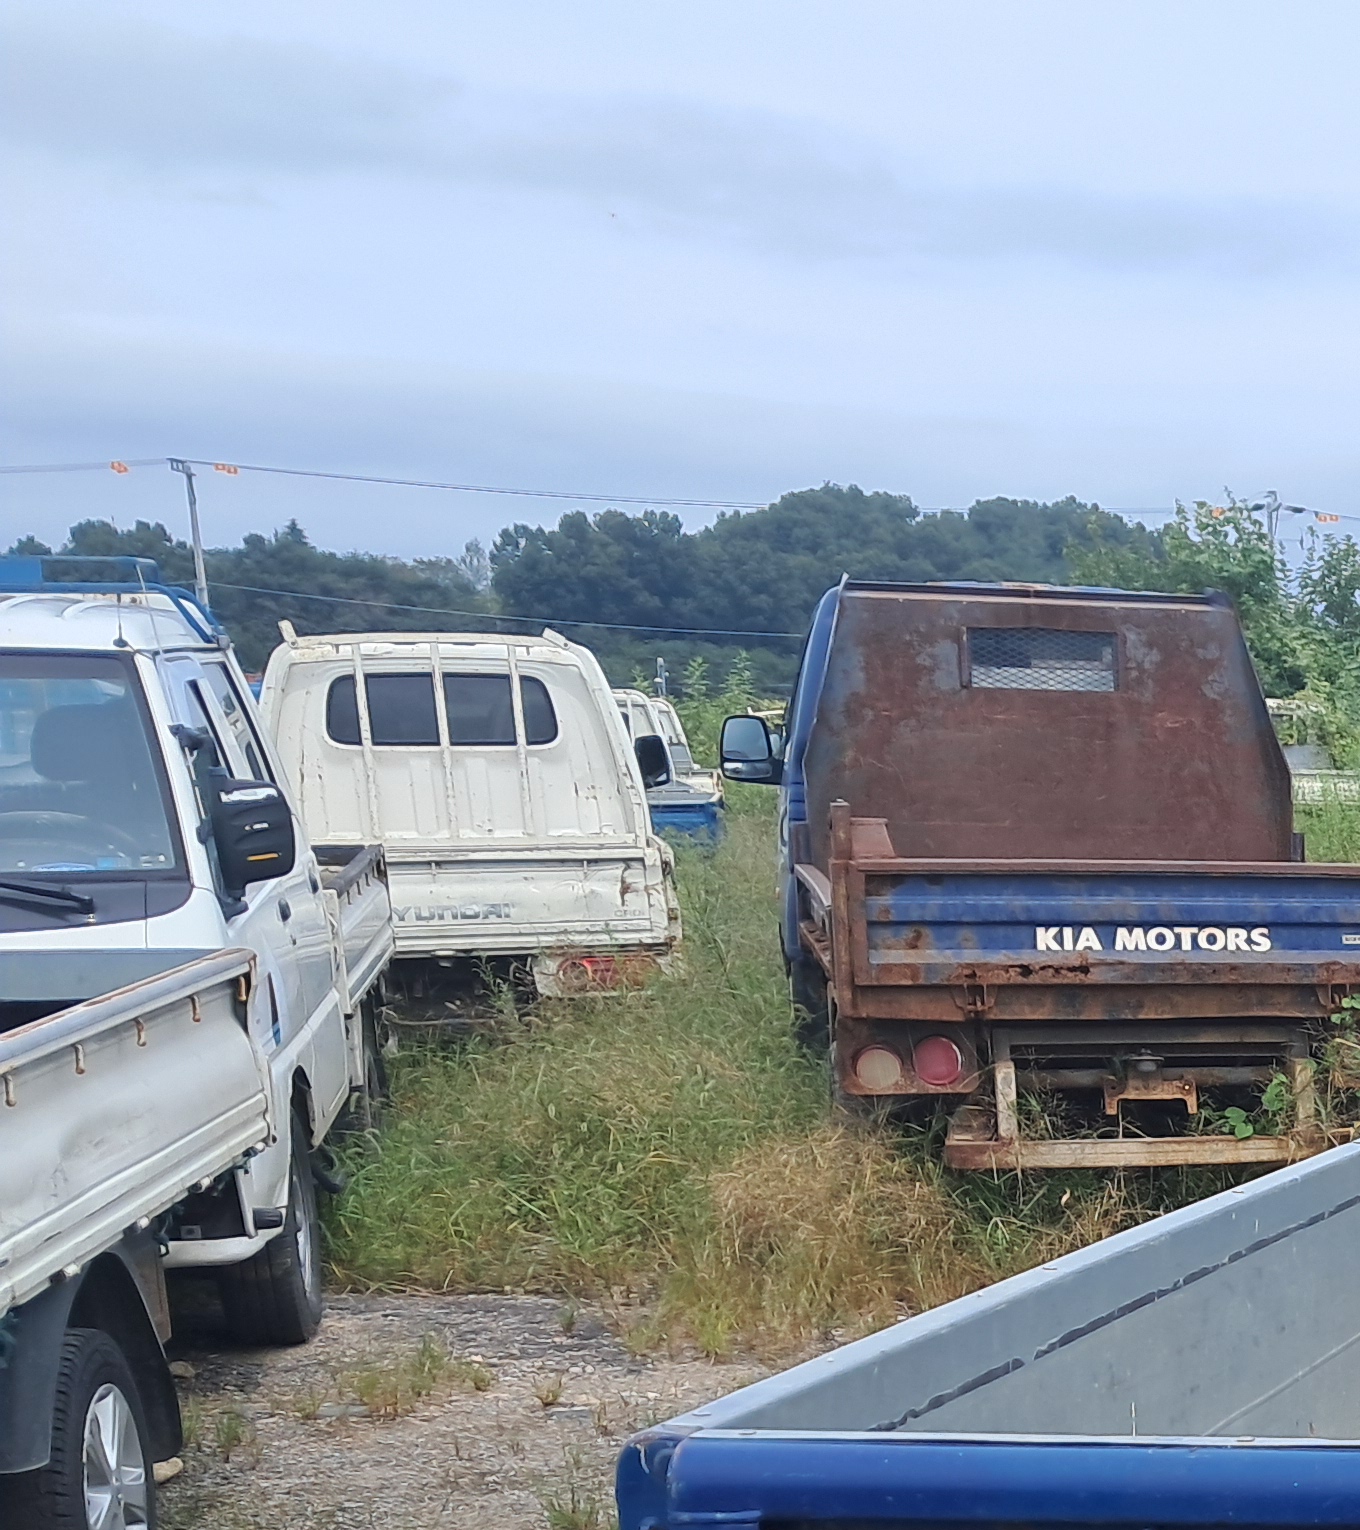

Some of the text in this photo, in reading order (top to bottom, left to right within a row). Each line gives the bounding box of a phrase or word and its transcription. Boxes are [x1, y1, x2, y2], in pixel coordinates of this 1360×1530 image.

[392, 903, 512, 921] YUNDAI
[1035, 926, 1272, 952] KIA MOTORS
